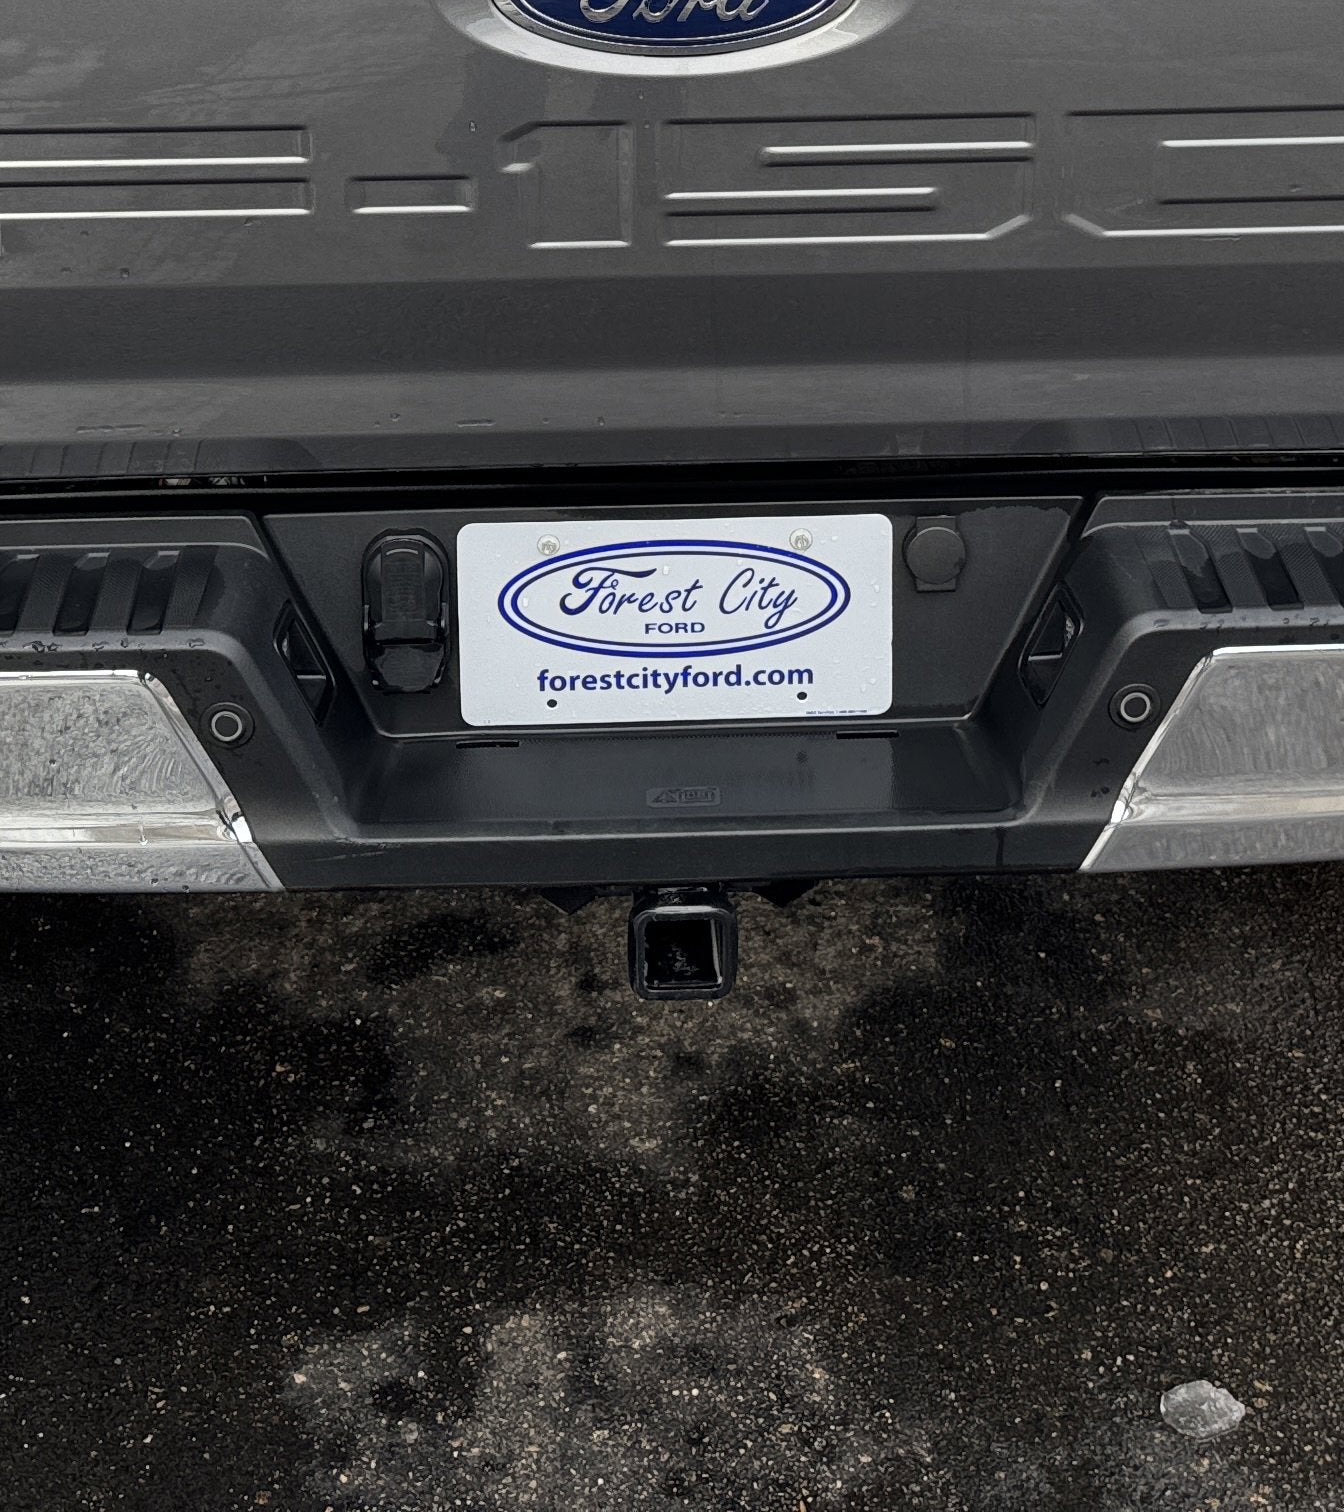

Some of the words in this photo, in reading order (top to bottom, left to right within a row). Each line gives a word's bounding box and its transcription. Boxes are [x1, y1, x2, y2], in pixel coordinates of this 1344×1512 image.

[559, 566, 704, 616] Forest
[718, 567, 799, 630] City
[644, 622, 706, 635] FORD
[537, 665, 815, 695] forestcityford.com
